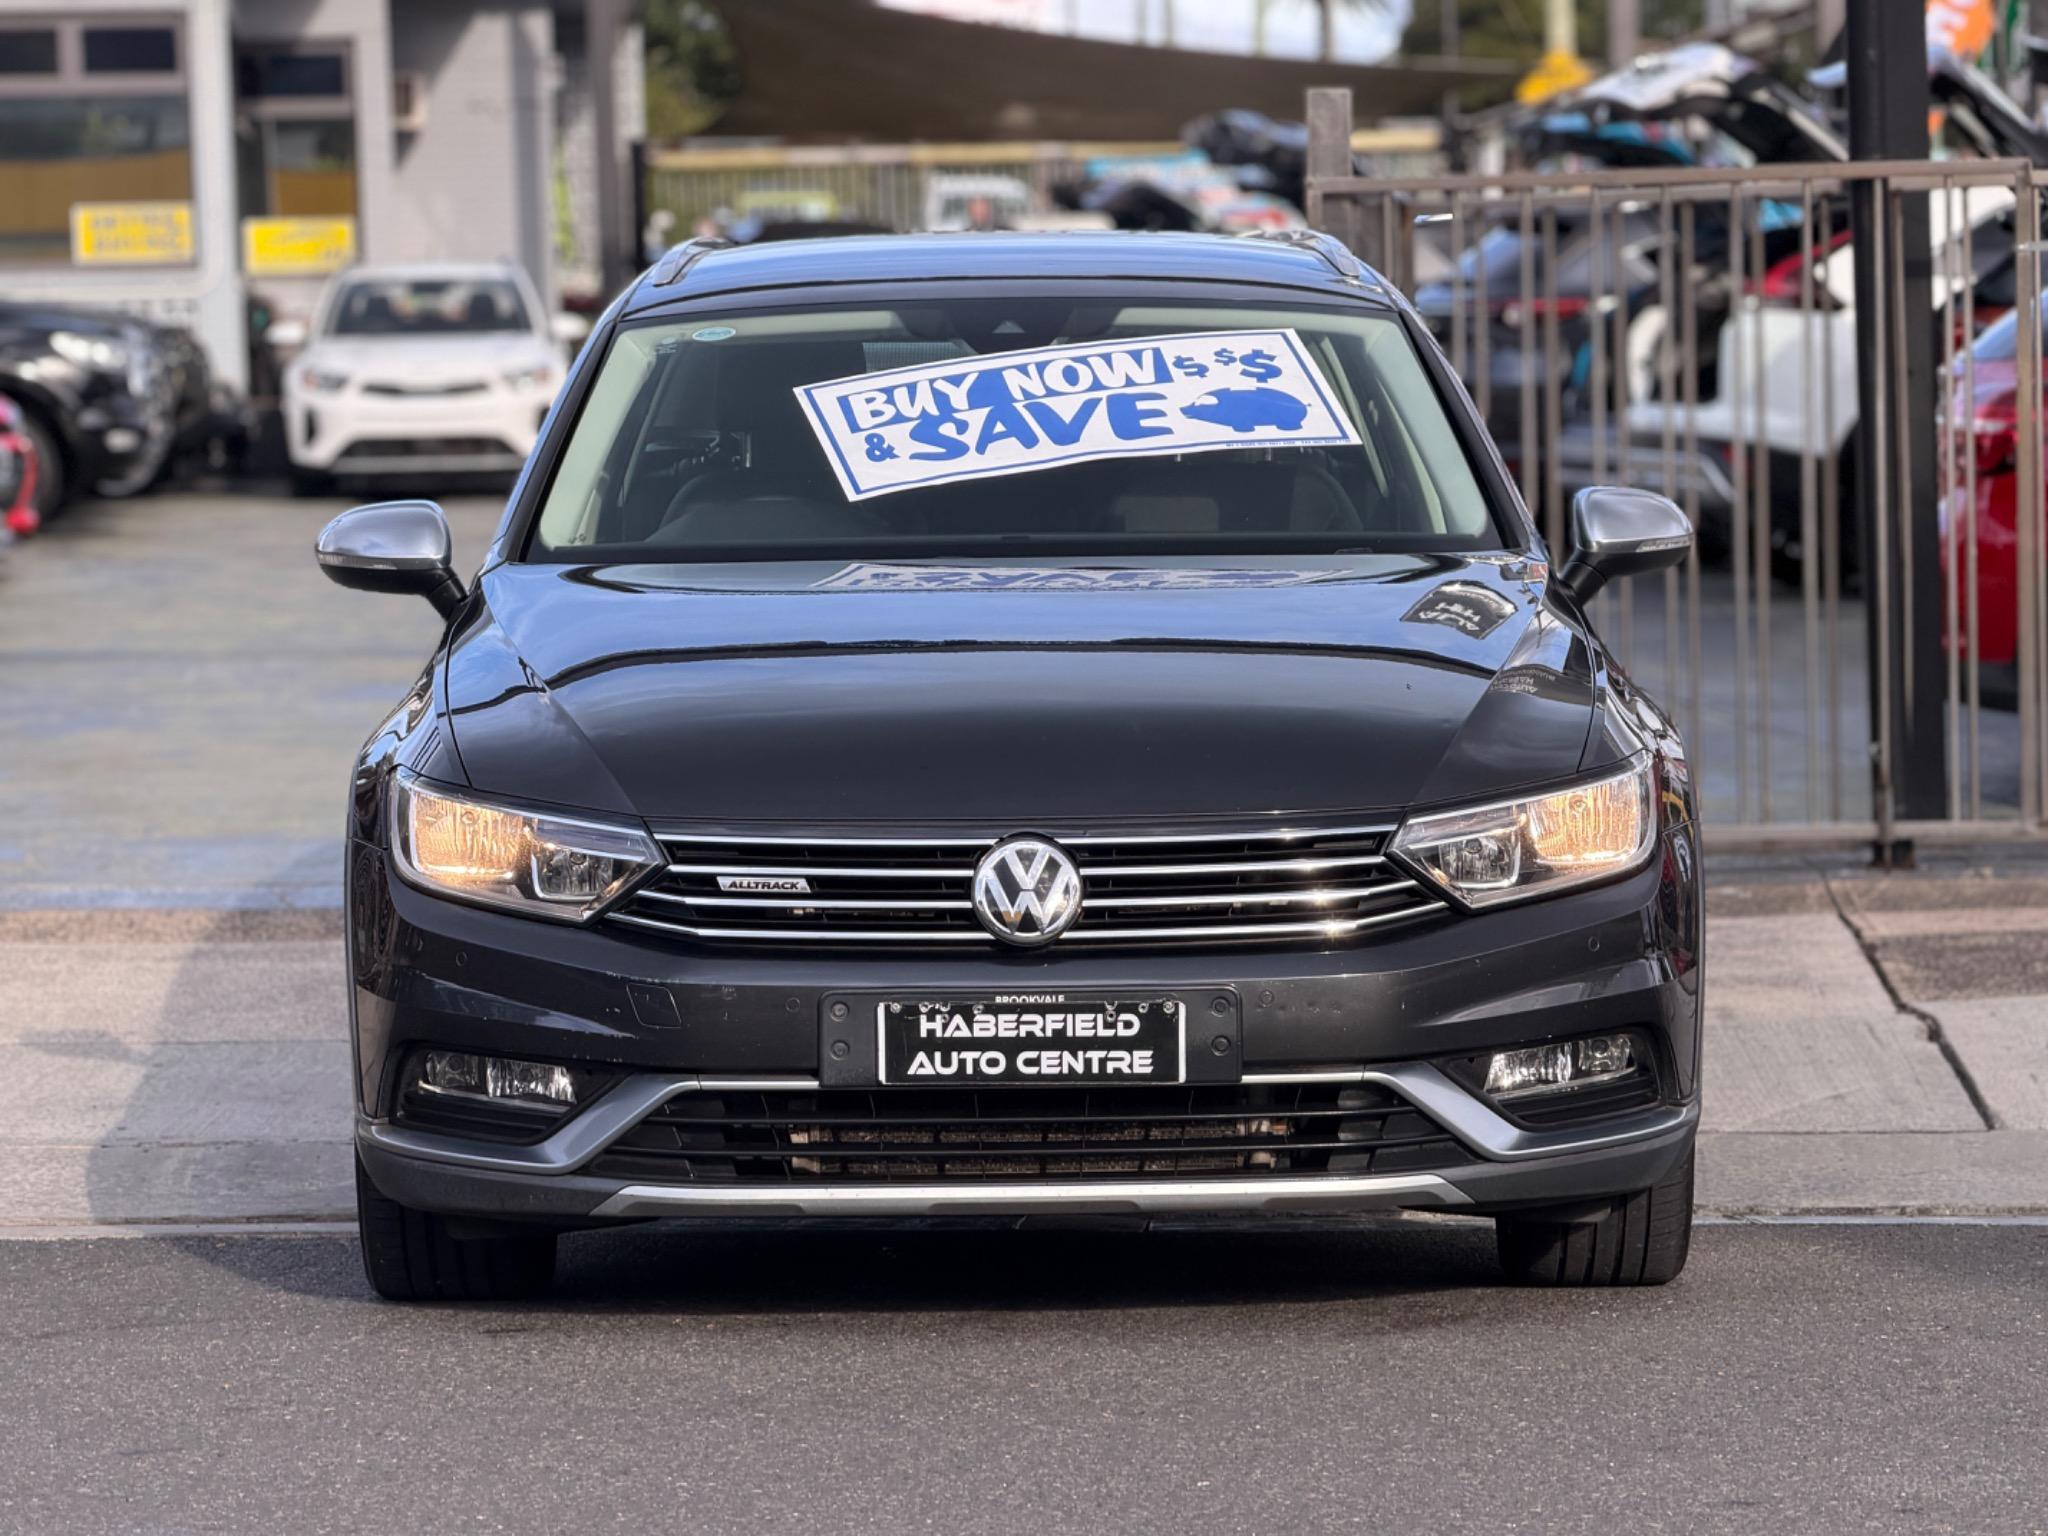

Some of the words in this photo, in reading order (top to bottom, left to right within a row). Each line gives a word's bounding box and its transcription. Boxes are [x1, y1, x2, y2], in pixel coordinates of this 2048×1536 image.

[848, 371, 980, 430] BUY
[1001, 349, 1157, 401] NOW
[863, 432, 902, 463] &
[908, 392, 1175, 462] SAVE
[727, 879, 801, 892] ALLTRACK
[918, 1013, 1141, 1038] HABERFIELD
[906, 1050, 1007, 1075] AUTO
[1015, 1050, 1155, 1075] CENTRE
